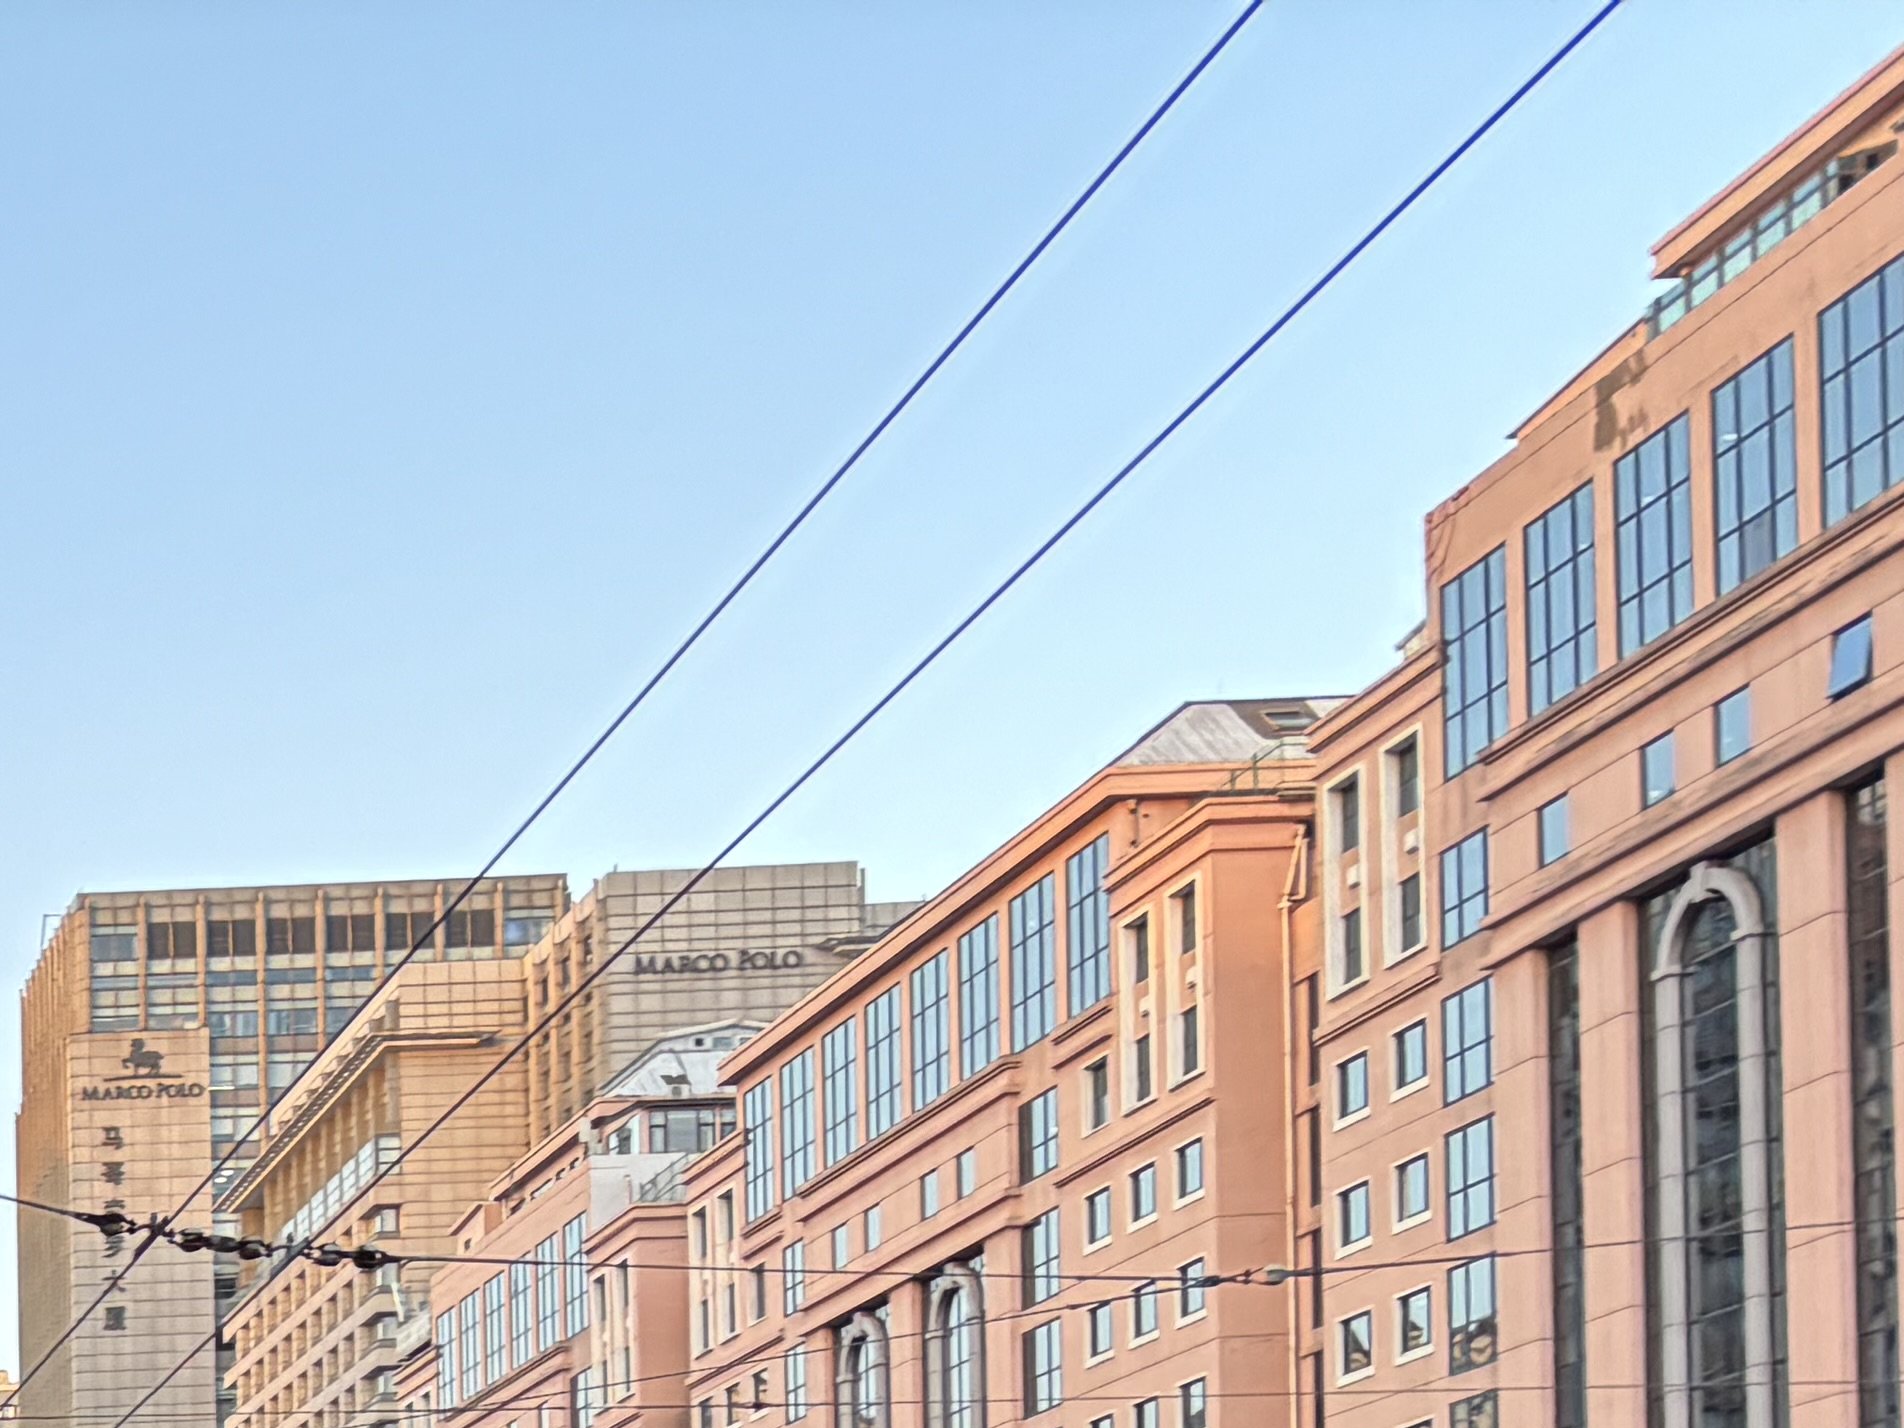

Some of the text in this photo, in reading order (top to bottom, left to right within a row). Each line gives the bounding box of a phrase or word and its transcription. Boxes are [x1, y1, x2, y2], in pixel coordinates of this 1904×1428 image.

[635, 950, 803, 975] MARCO POLO
[81, 1082, 206, 1101] MARCO POLO
